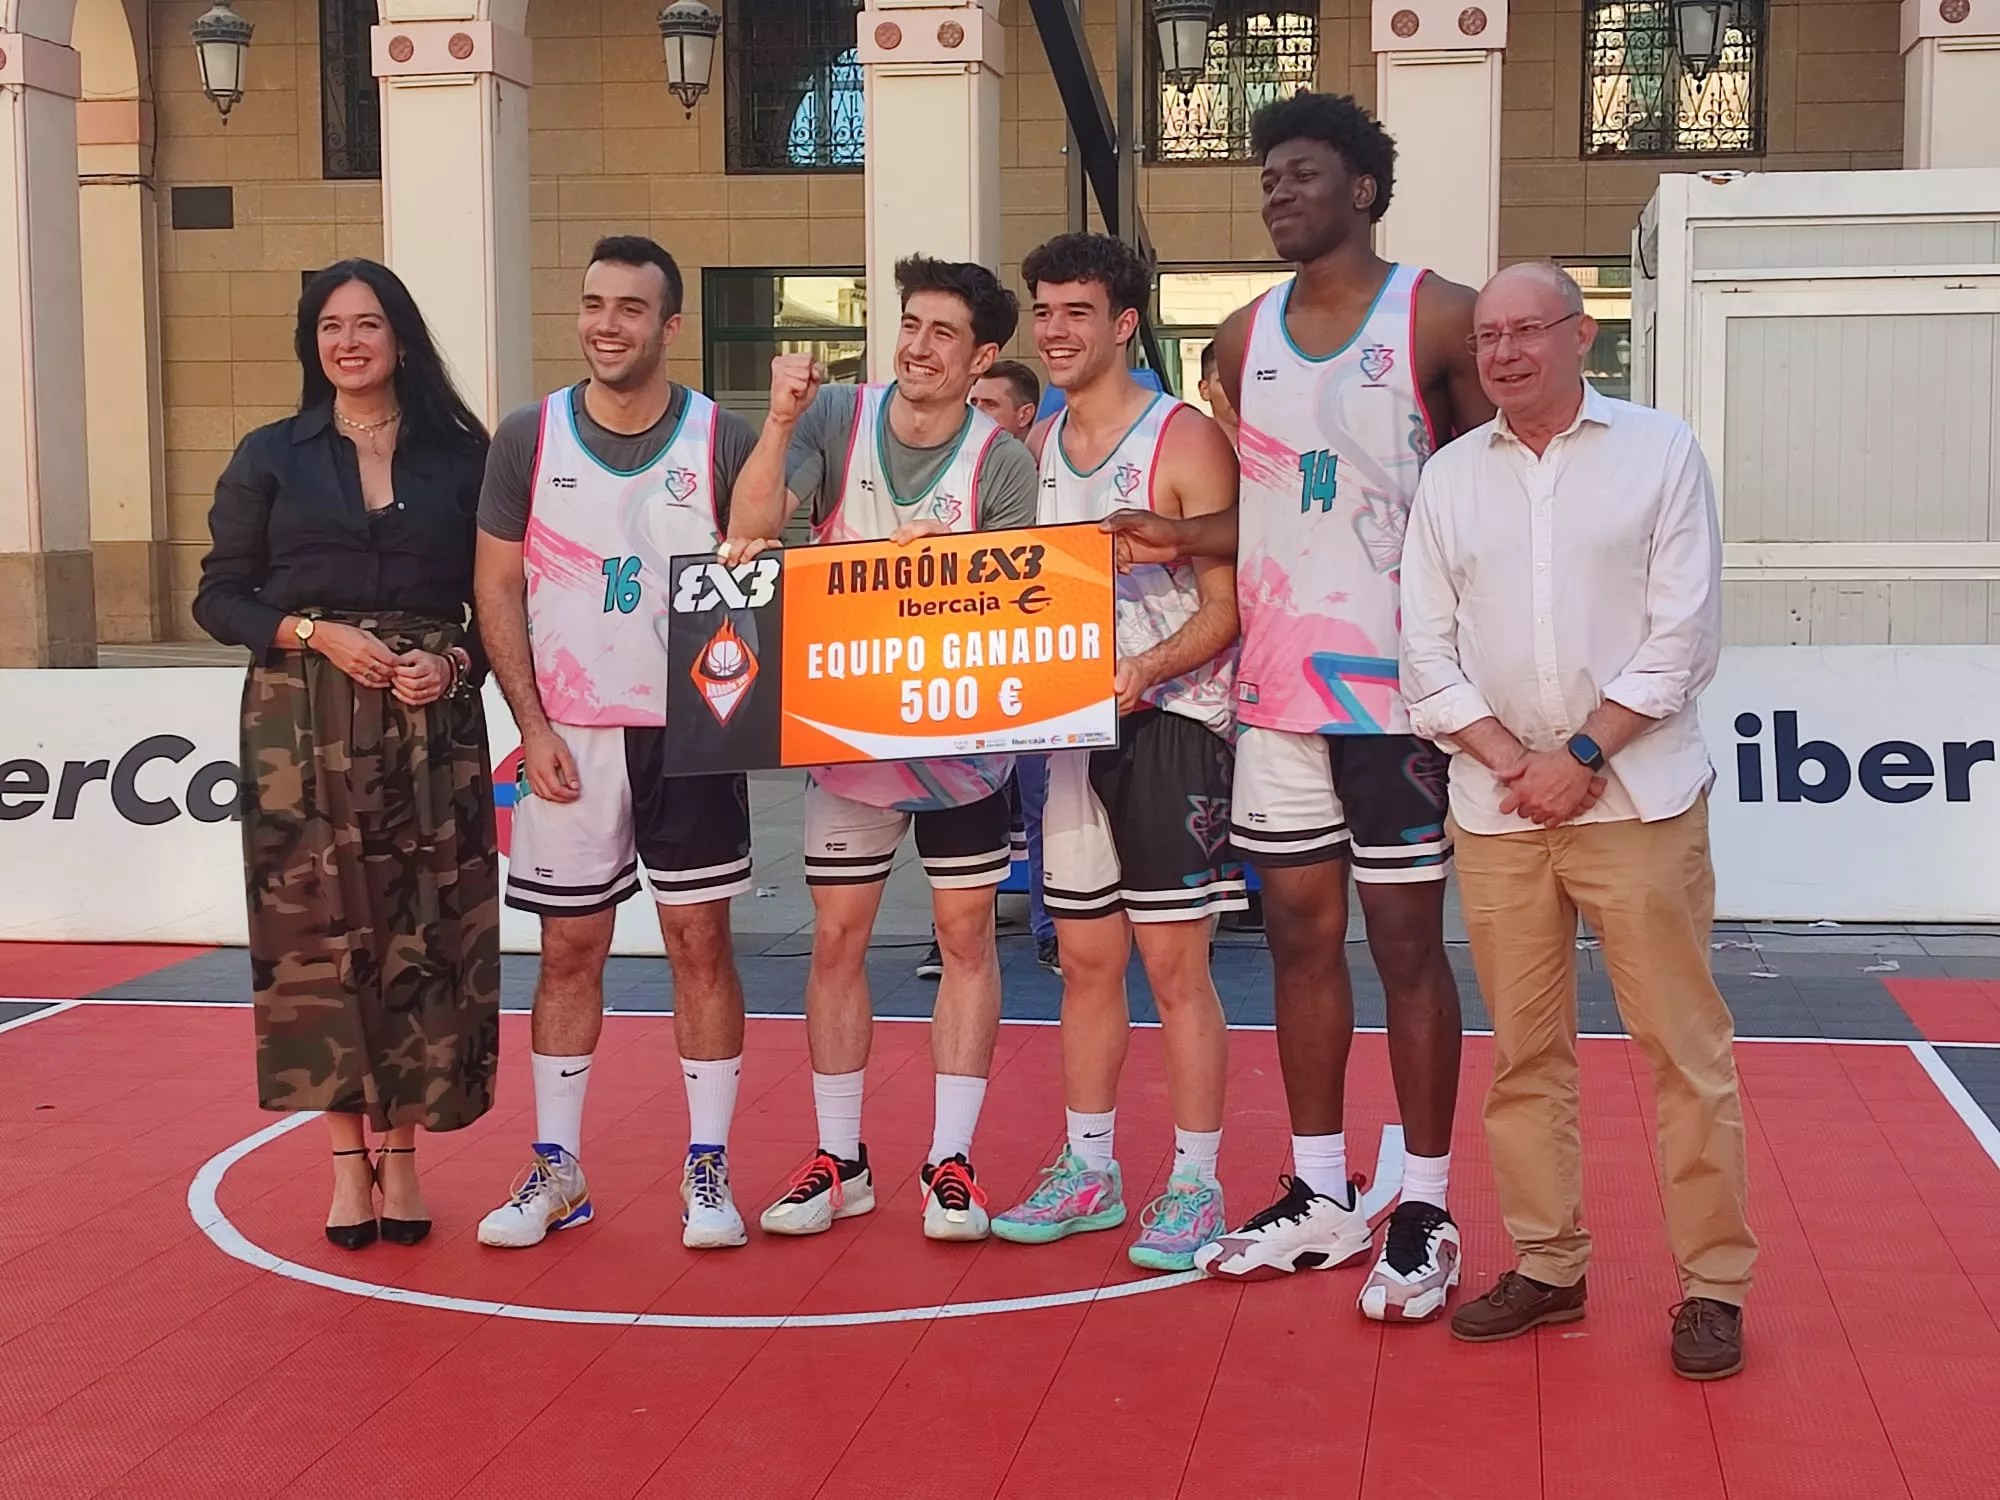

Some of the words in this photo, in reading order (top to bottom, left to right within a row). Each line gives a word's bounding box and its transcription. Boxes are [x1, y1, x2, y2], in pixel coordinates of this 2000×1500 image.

[1298, 449, 1338, 513] 14
[602, 555, 643, 614] 16
[827, 546, 958, 595] ARAGÓN
[898, 591, 1000, 618] Ibercaja
[807, 635, 926, 680] EQUIPO
[942, 622, 1101, 669] GANADOR
[900, 675, 978, 724] 500
[998, 676, 1024, 717] €
[1734, 710, 1996, 804] iber
